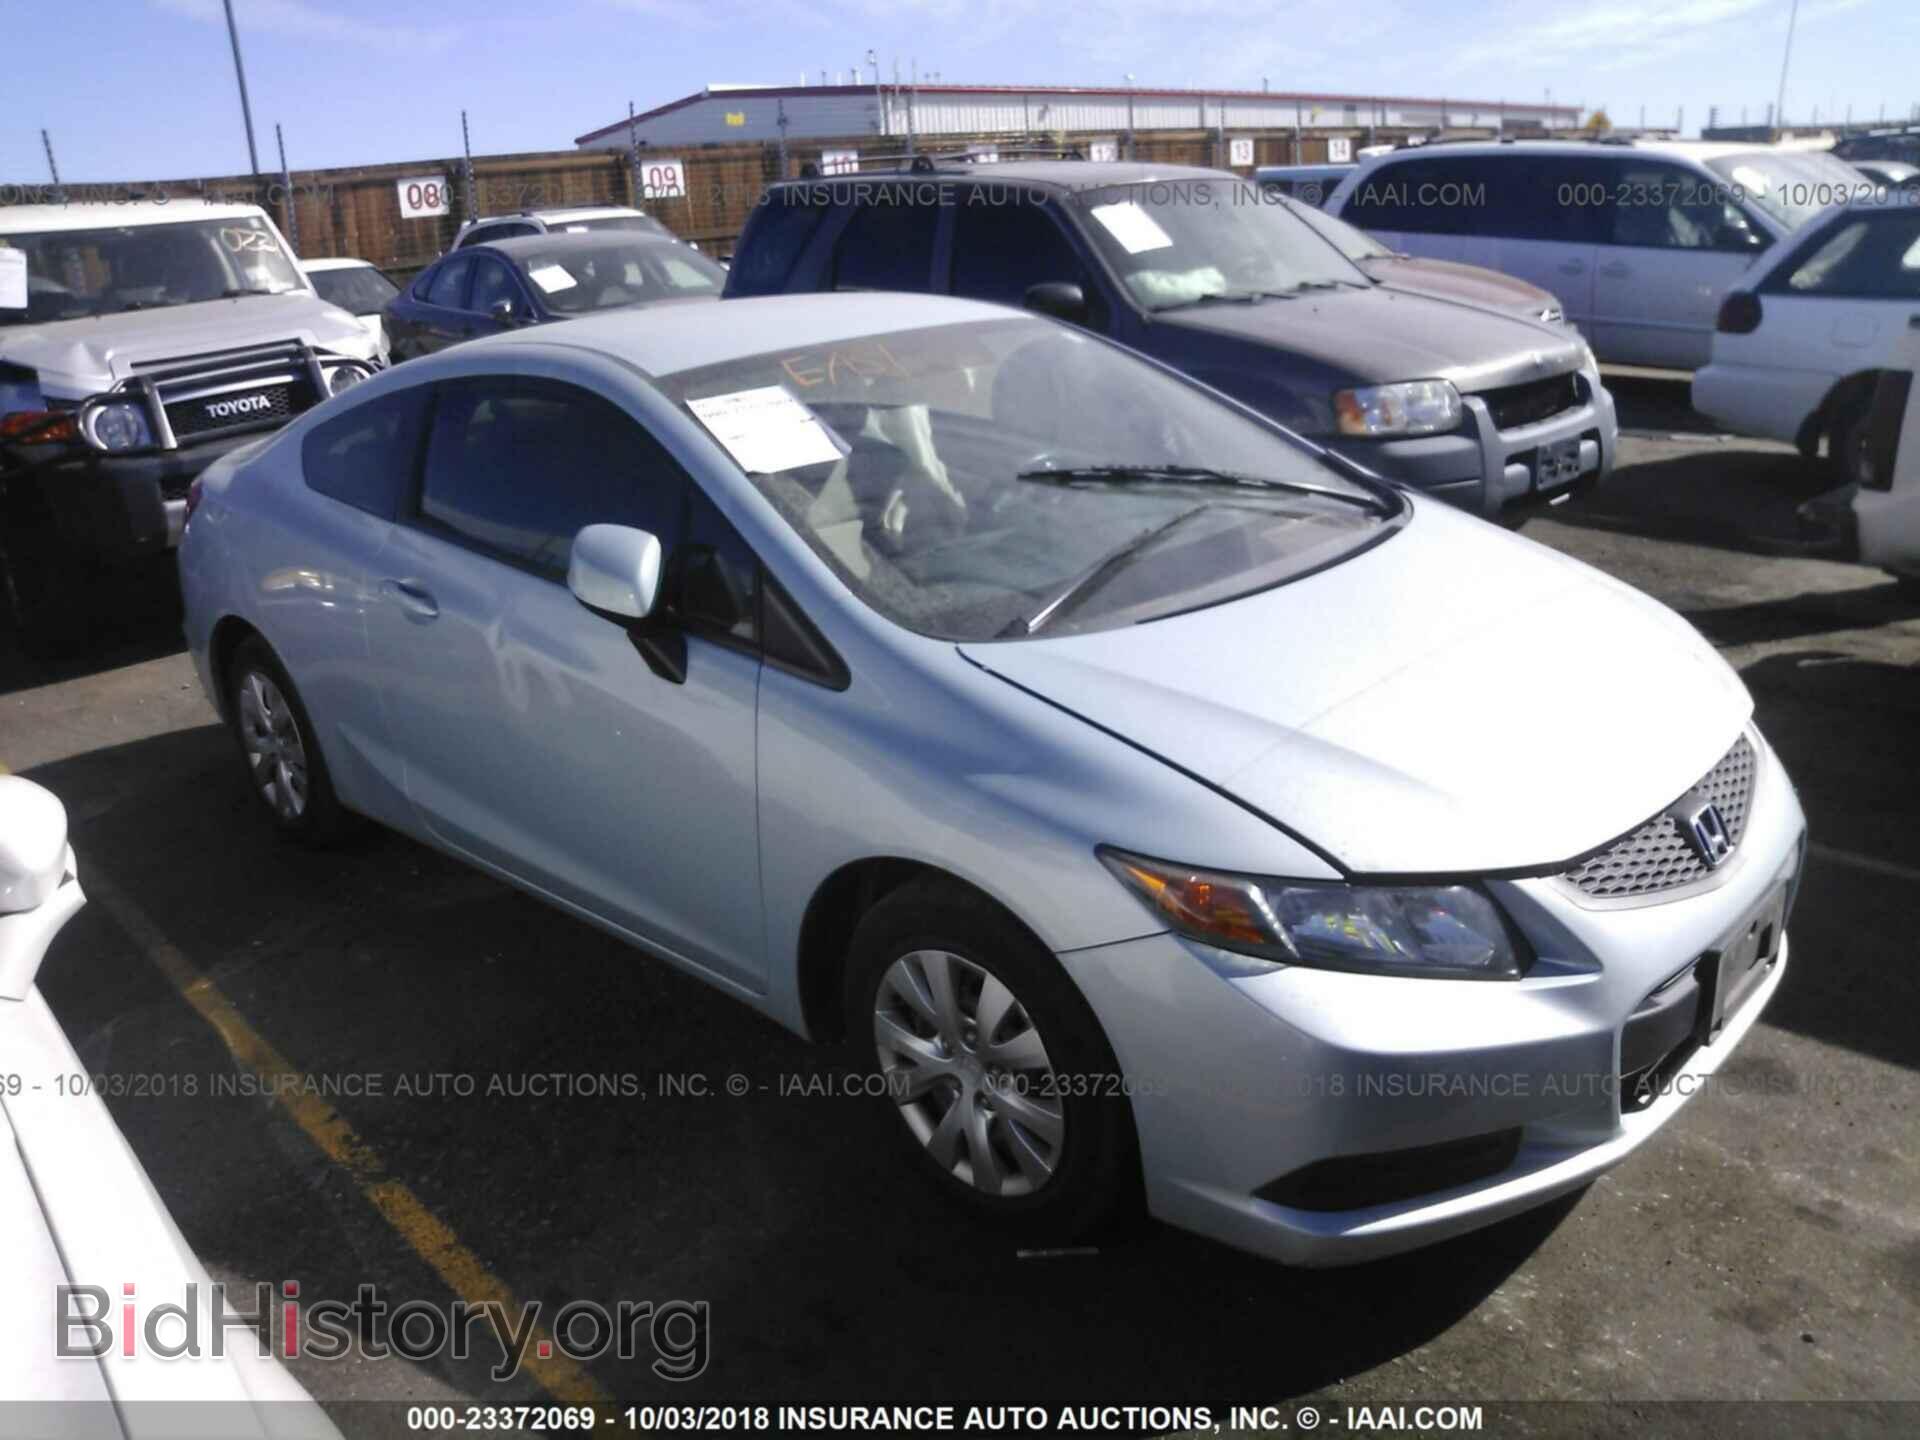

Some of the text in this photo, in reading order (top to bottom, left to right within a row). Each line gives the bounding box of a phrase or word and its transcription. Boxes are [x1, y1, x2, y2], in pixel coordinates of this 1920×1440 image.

[649, 166, 676, 190] 09
[407, 183, 439, 209] 08
[205, 395, 271, 418] TOYOTA
